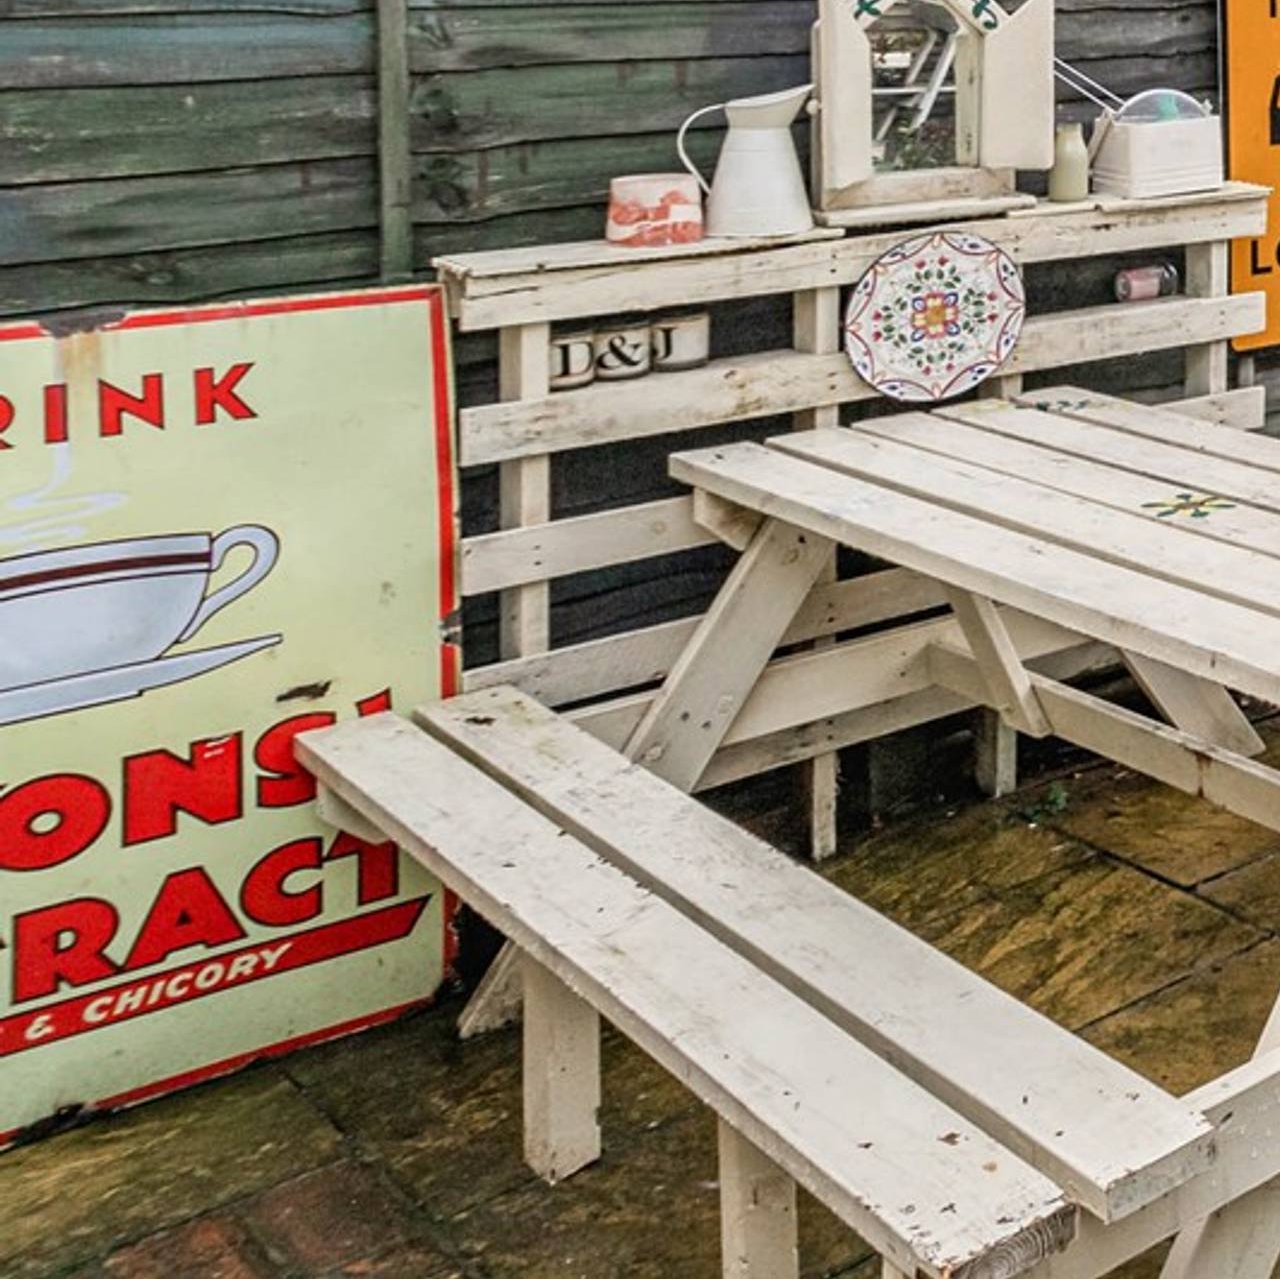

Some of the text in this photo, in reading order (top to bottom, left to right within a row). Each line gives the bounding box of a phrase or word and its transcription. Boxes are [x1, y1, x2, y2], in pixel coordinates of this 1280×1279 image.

[0, 362, 258, 449] INK
[0, 829, 400, 1006] RACT
[24, 941, 294, 1041] & CHICORY
